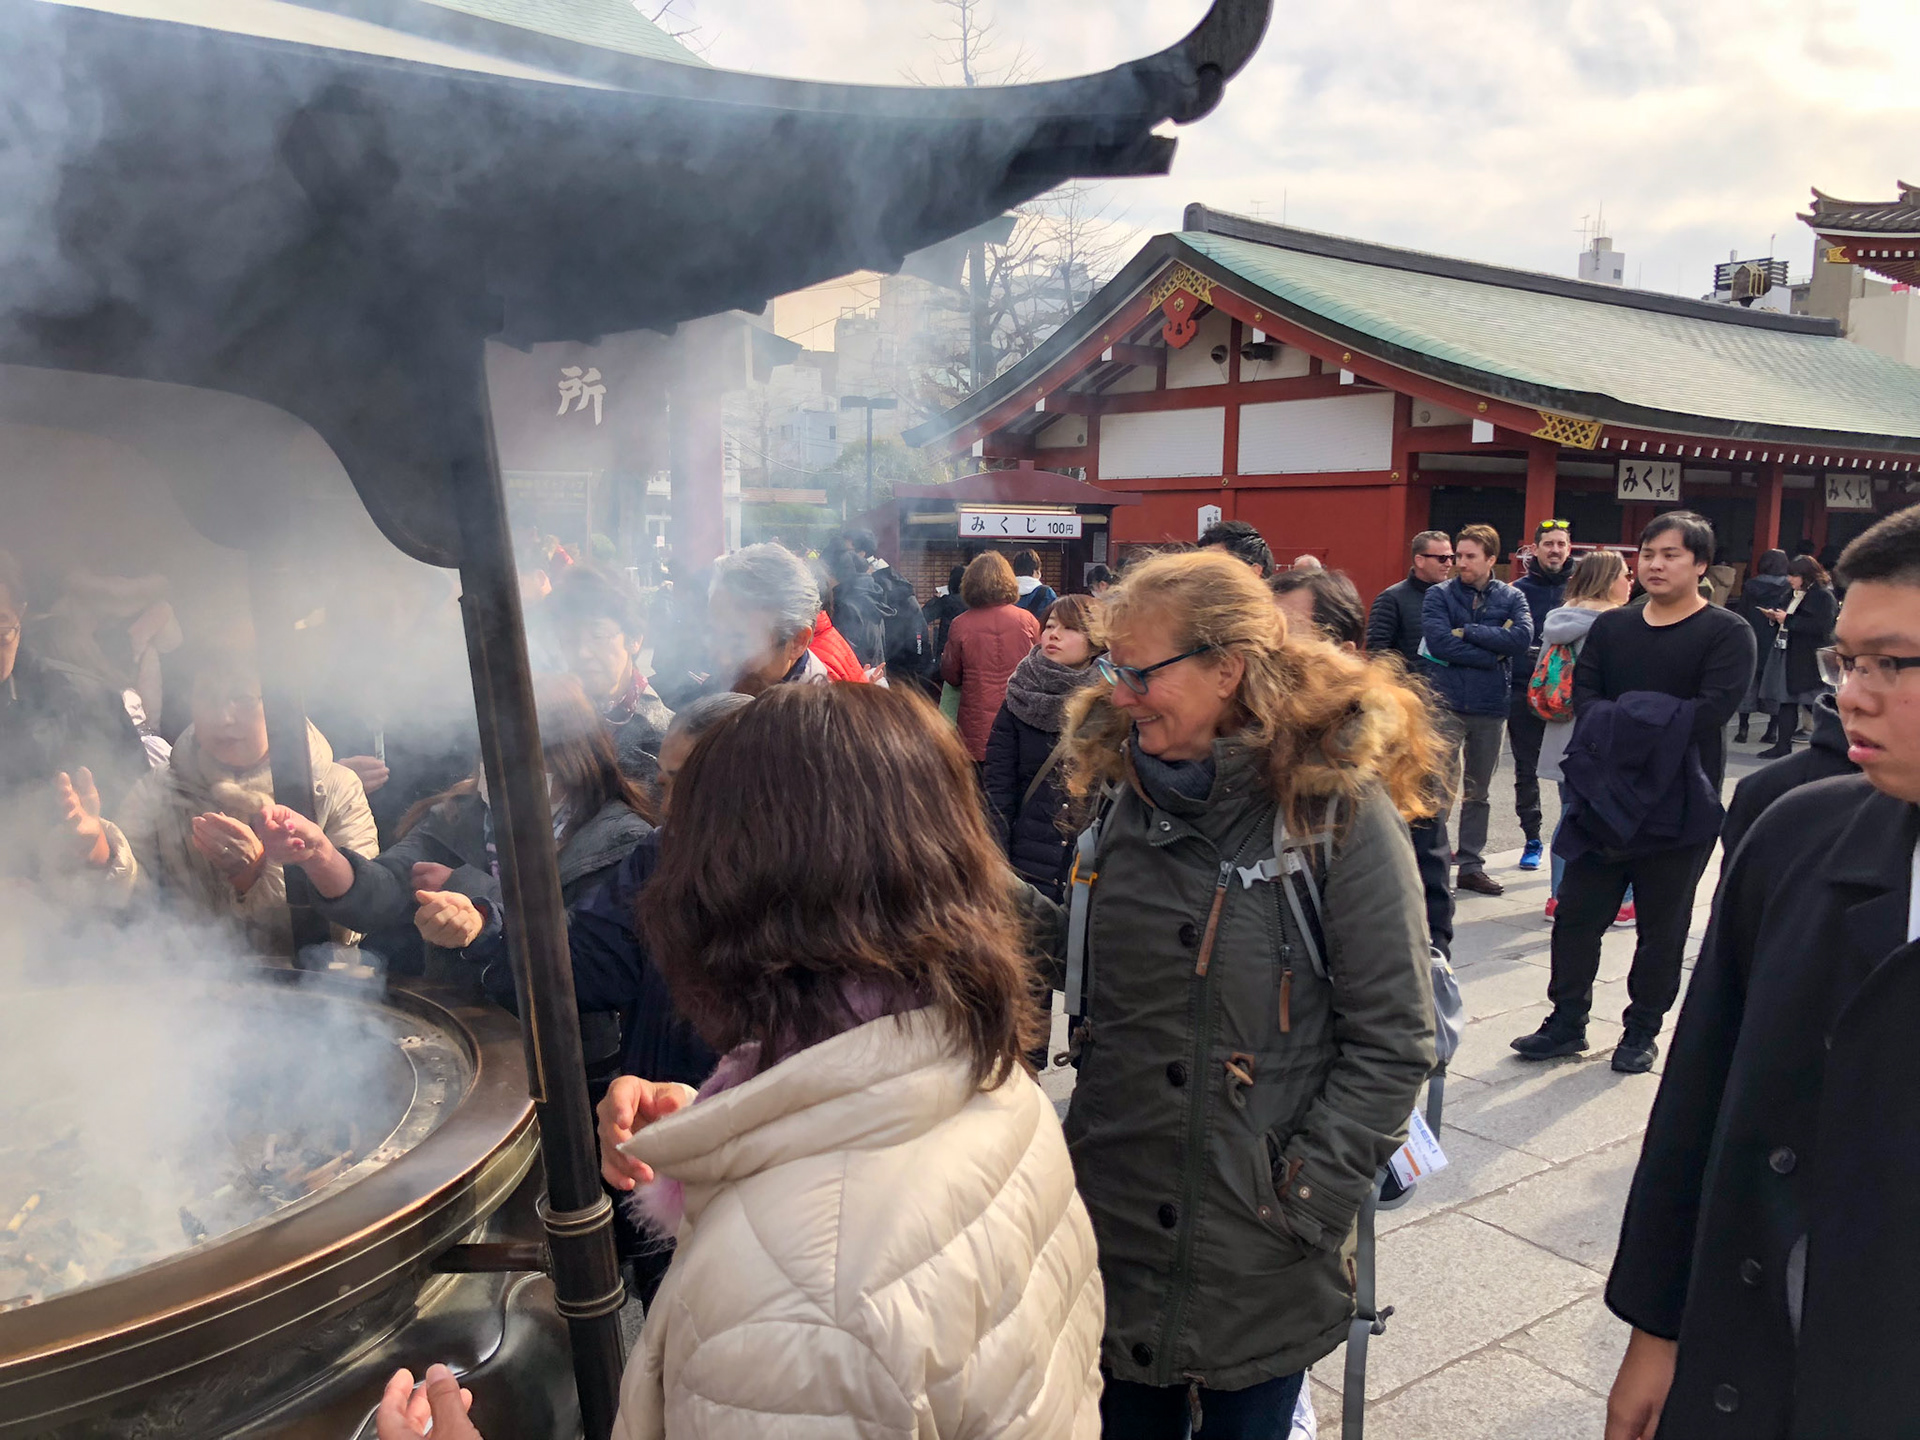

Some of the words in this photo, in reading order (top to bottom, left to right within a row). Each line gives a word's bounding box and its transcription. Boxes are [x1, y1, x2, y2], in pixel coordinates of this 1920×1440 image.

[556, 365, 607, 426] 所
[1623, 466, 1675, 493] みくじ
[1828, 479, 1868, 501] みくじ
[971, 516, 1037, 534] みくじ
[1047, 522, 1075, 535] 100円
